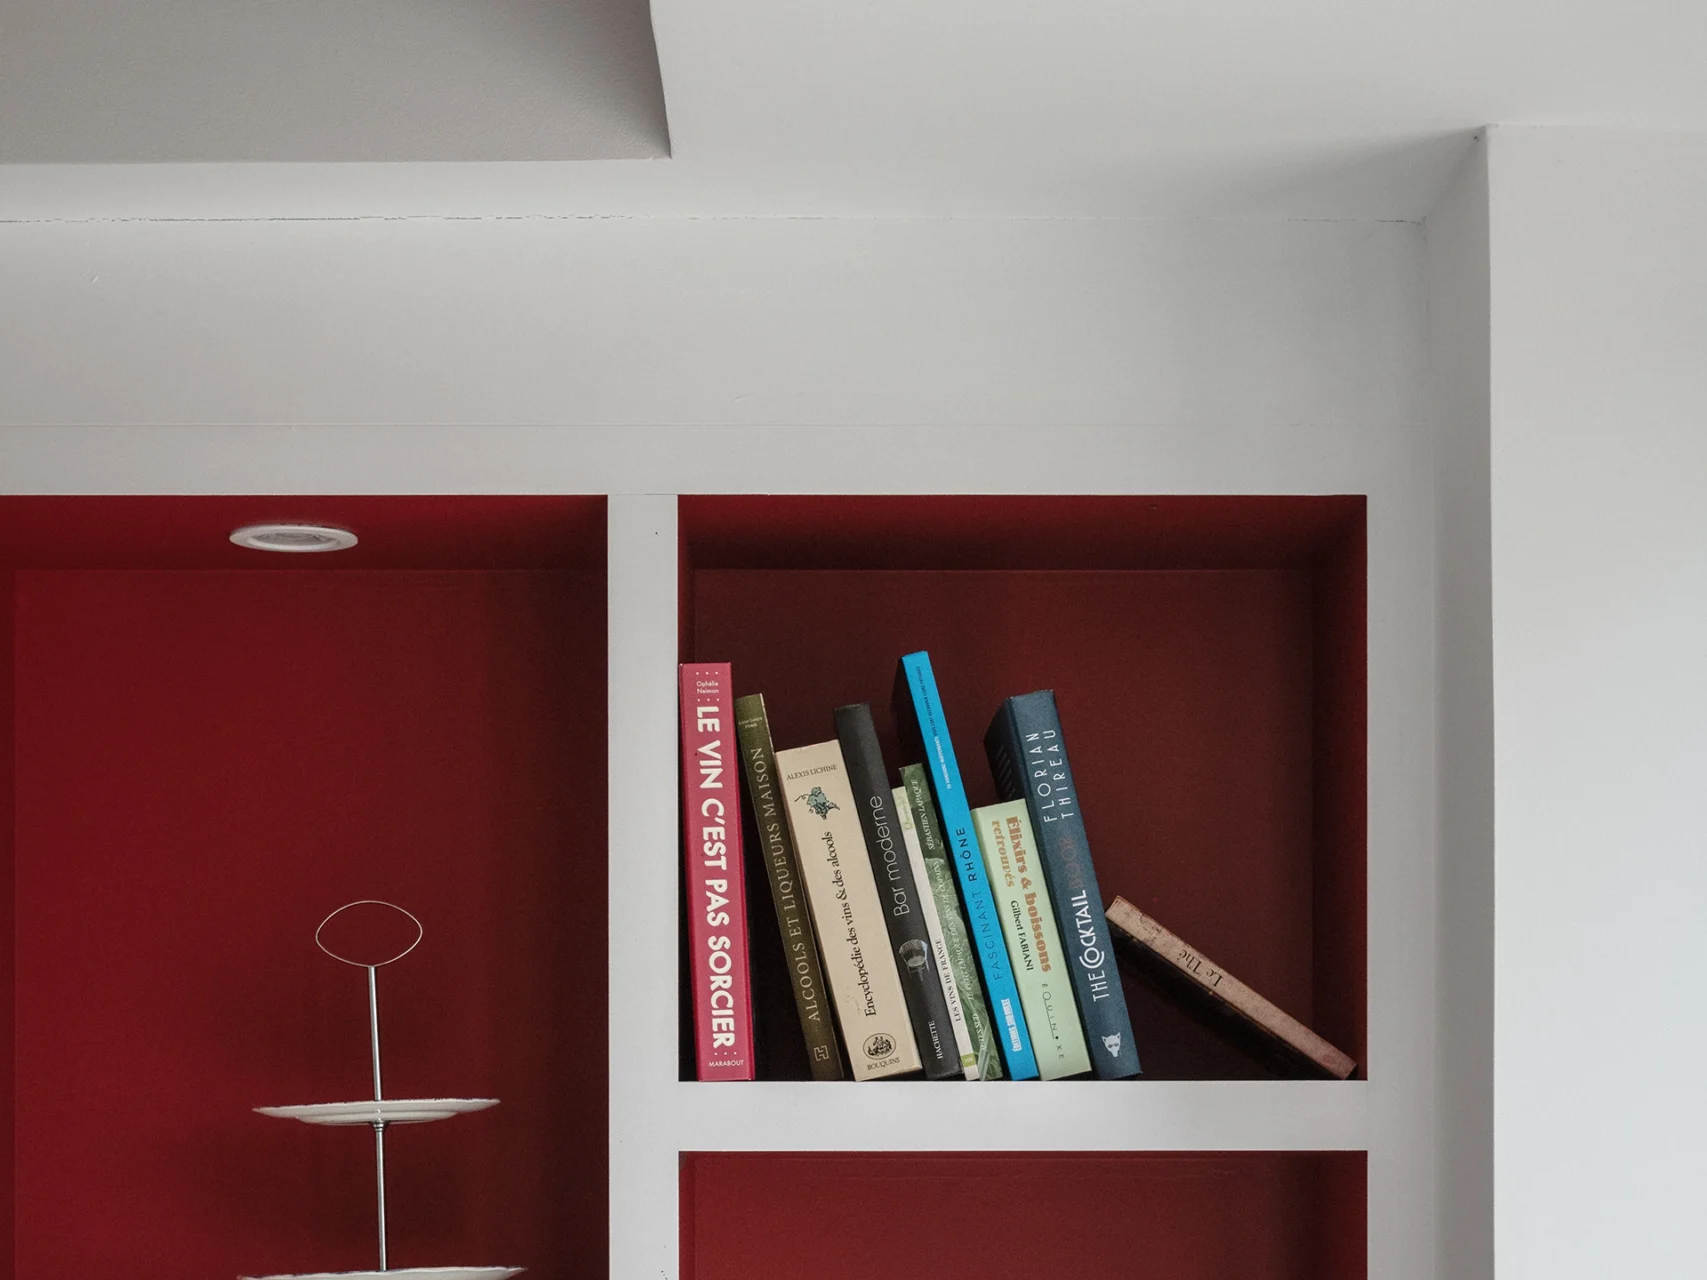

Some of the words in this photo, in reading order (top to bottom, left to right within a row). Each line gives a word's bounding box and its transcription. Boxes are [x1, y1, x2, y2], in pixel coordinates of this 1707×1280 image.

[697, 706, 721, 733] LE
[697, 740, 724, 789] VIN
[751, 748, 777, 816] MAISON
[786, 769, 809, 781] ALEXIS
[810, 764, 838, 776] LICHINE
[1026, 732, 1057, 823] FLORIAN
[1043, 729, 1075, 820] THIREAU
[910, 779, 927, 813] LAPAQUE
[701, 798, 728, 870] C'EST
[821, 831, 841, 868] alcools
[869, 795, 900, 882] moderne
[919, 813, 935, 850] SÉBASTIEN
[1006, 815, 1028, 874] Élixirs
[767, 823, 797, 911] LIQUEURS
[956, 827, 978, 882] RHÔNE
[991, 820, 1015, 888] retrouvés
[832, 869, 844, 888] des
[835, 888, 848, 900] &
[1020, 876, 1032, 890] &
[705, 879, 730, 926] PAS
[842, 903, 854, 927] vins
[892, 888, 911, 917] Bar
[787, 918, 802, 938] ET
[846, 927, 858, 947] des
[974, 892, 1003, 980] FASCINANT
[1011, 900, 1023, 932] Gilbert
[1017, 932, 1034, 972] FABIANI
[1024, 892, 1052, 973] boissons
[1070, 889, 1105, 969] COCKTAIL
[935, 938, 950, 972] FRANCE
[1176, 949, 1203, 972] Thé
[707, 936, 736, 1048] SORCIER
[792, 942, 821, 1022] ALCOOLS
[851, 947, 877, 1017] Encyclopédie
[943, 972, 953, 985] DE
[946, 985, 958, 1005] VINS
[1088, 969, 1110, 1002] THE
[1206, 968, 1223, 987] Le
[952, 1004, 962, 1022] LES
[928, 1020, 944, 1060] HACHETTE
[867, 1057, 900, 1071] BOUQUINS
